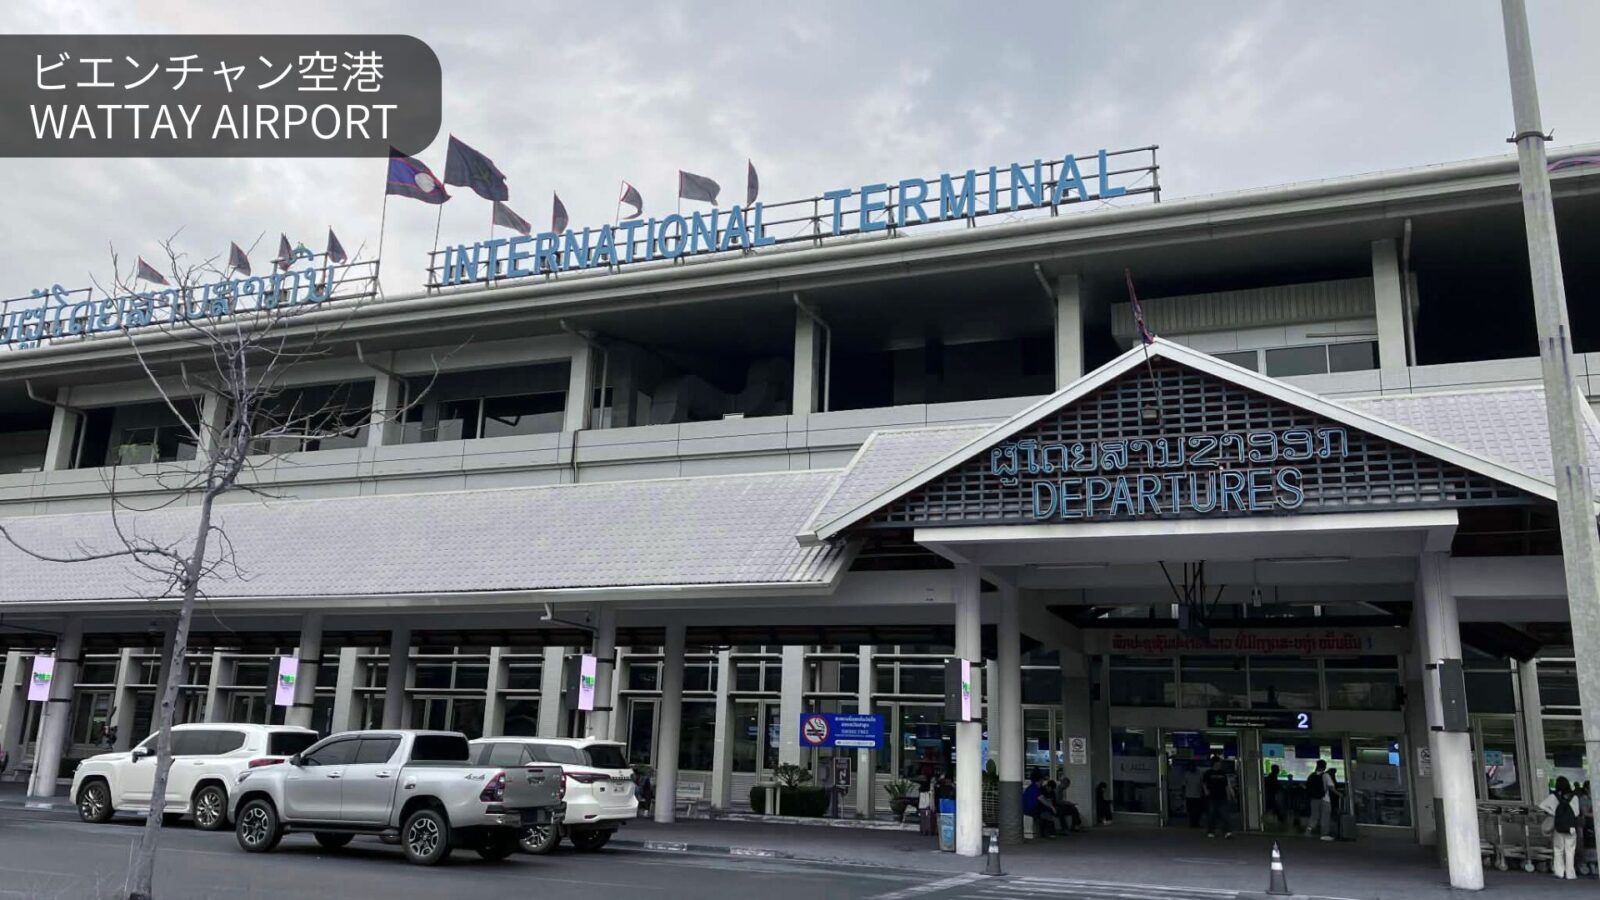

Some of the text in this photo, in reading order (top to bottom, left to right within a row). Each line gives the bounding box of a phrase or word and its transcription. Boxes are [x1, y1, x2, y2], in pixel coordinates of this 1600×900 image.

[442, 149, 1128, 286] INTERNATIONAL TERMINAL
[1032, 467, 1304, 520] DEPARTURES
[1297, 712, 1309, 728] 2
